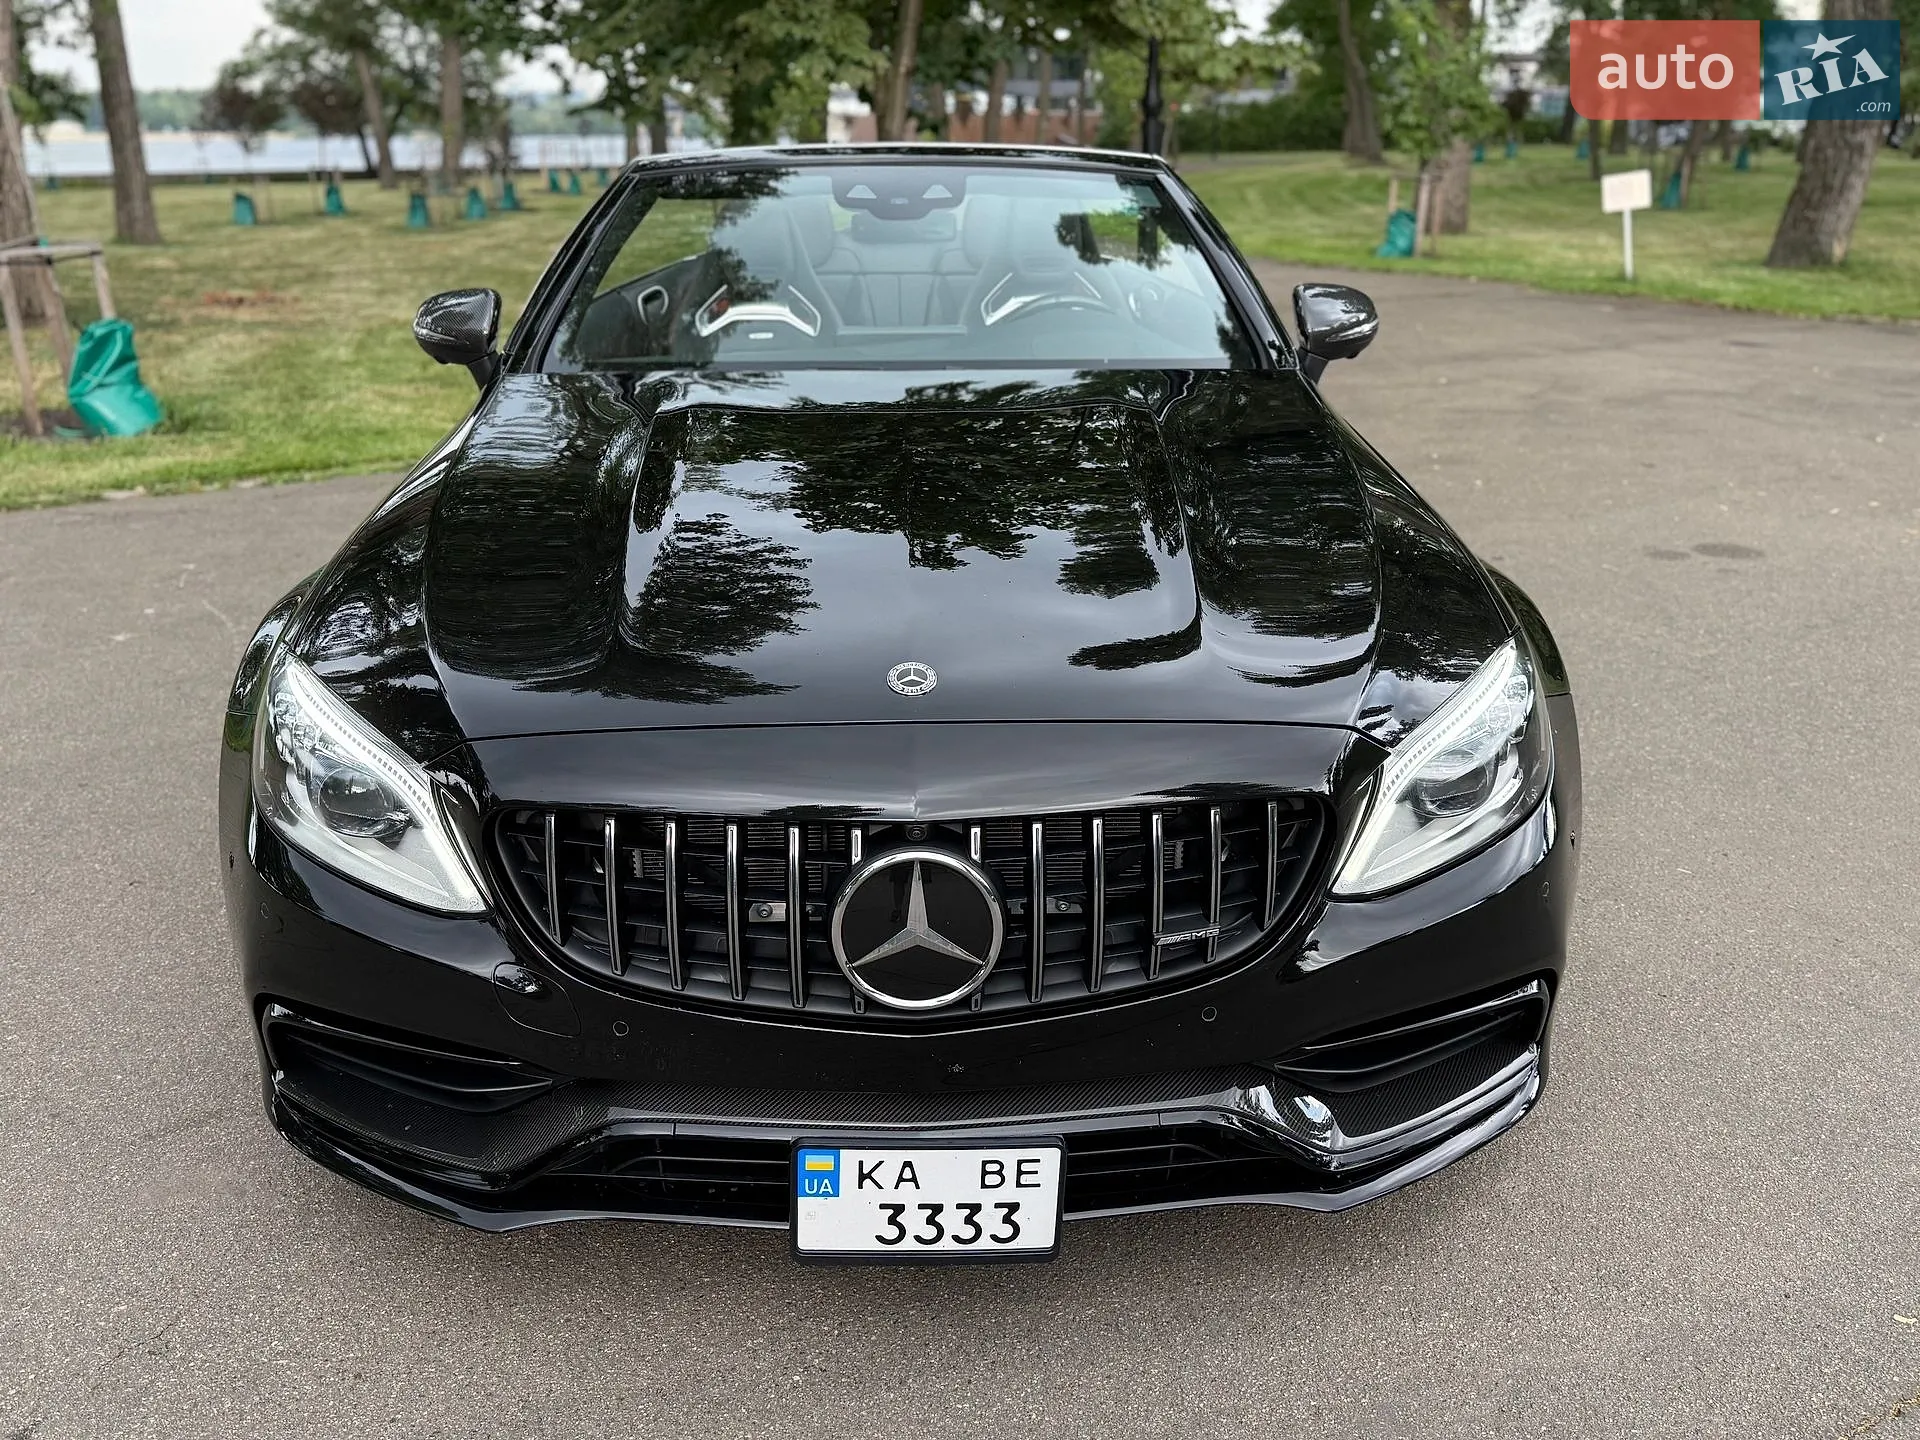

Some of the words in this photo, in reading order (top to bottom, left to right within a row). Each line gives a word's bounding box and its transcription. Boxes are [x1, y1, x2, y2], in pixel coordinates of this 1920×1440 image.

[804, 1178, 834, 1195] UA
[857, 1159, 921, 1190] KA
[980, 1158, 1041, 1189] BE
[874, 1201, 1022, 1246] 3333
